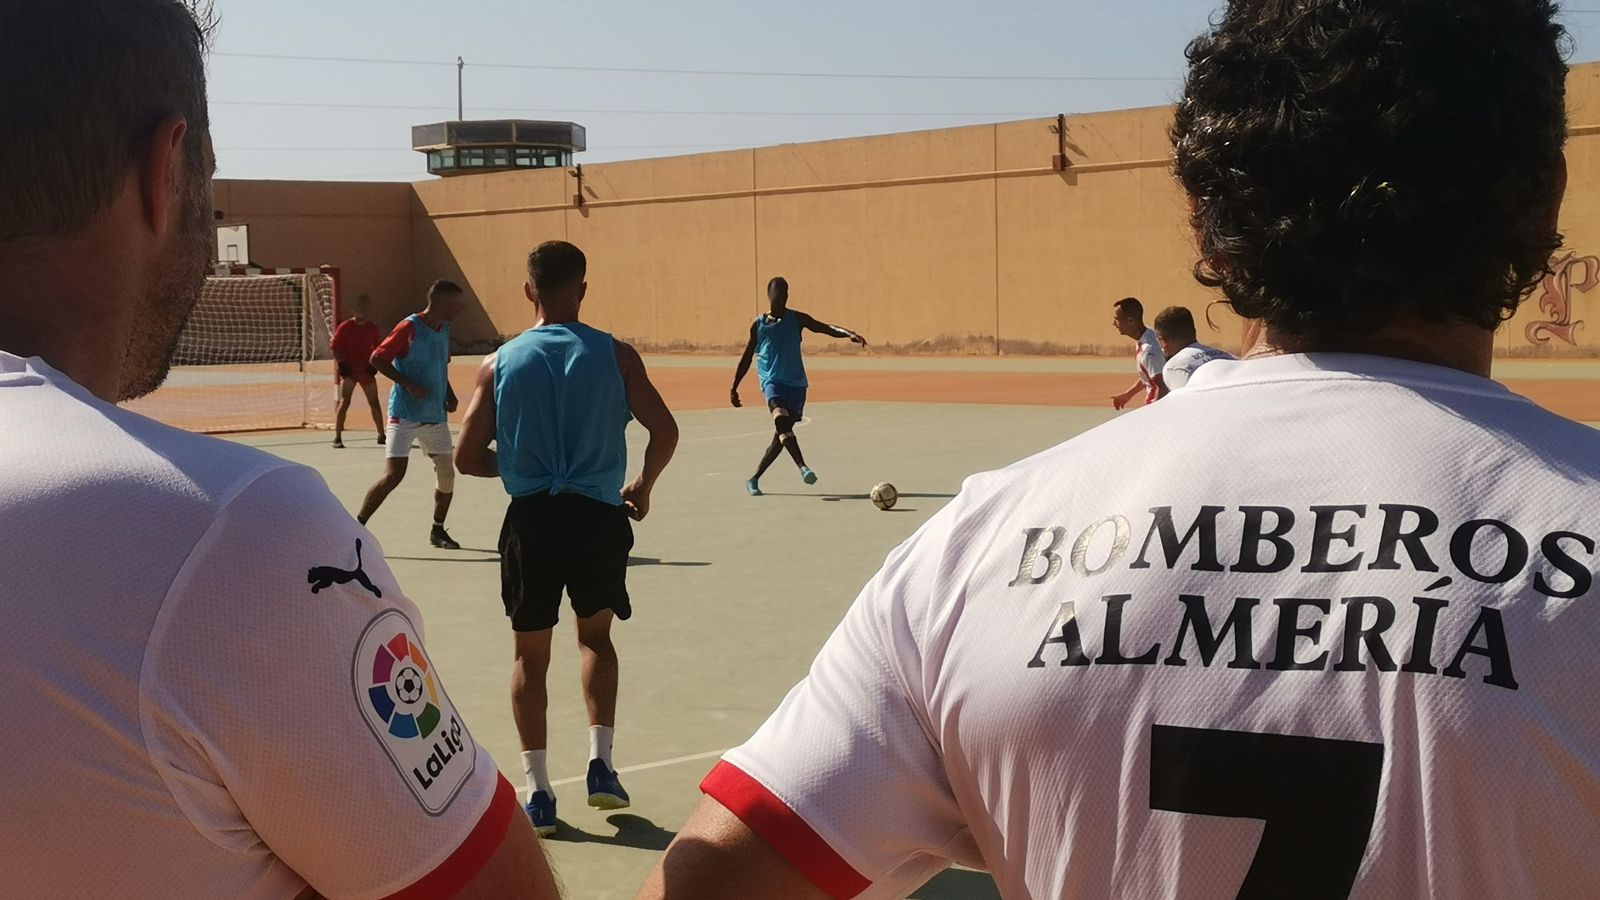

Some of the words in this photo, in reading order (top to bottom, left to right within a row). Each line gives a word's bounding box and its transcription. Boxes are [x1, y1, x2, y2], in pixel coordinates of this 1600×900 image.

[1008, 503, 1596, 599] BOMBEROS
[1027, 576, 1519, 691] ALMERÍA
[413, 715, 464, 790] LaLiga
[1150, 724, 1385, 900] 7
